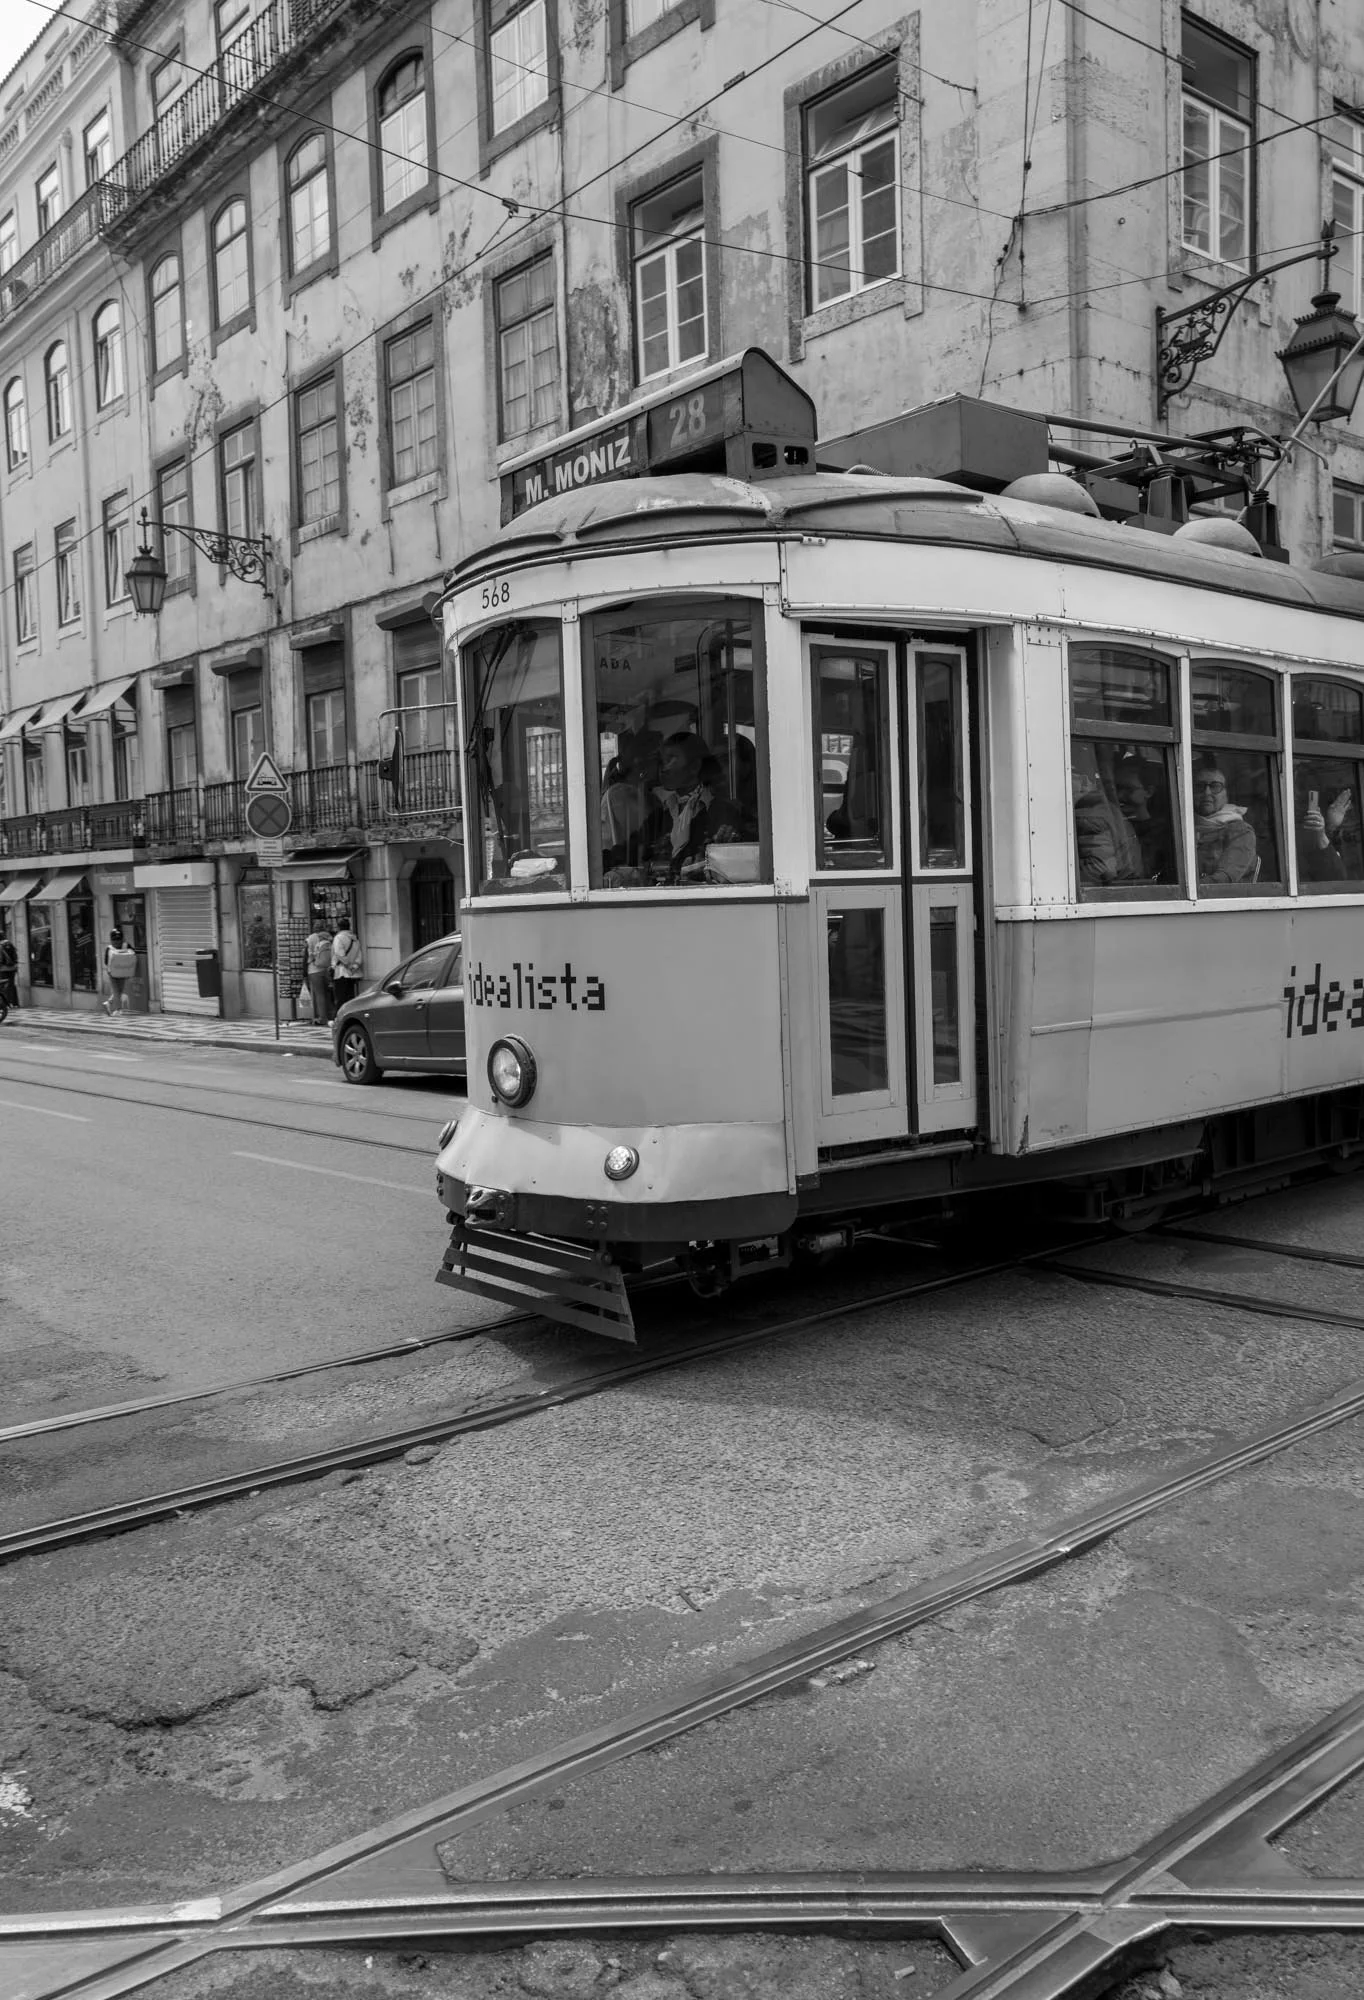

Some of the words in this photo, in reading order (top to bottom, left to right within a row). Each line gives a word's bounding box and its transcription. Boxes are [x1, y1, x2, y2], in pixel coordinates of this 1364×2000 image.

[669, 393, 706, 448] 28
[525, 474, 549, 505] M.
[555, 436, 631, 492] MONIZ
[482, 581, 510, 609] 568
[469, 961, 605, 1011] idealista
[1284, 963, 1364, 1038] idea
